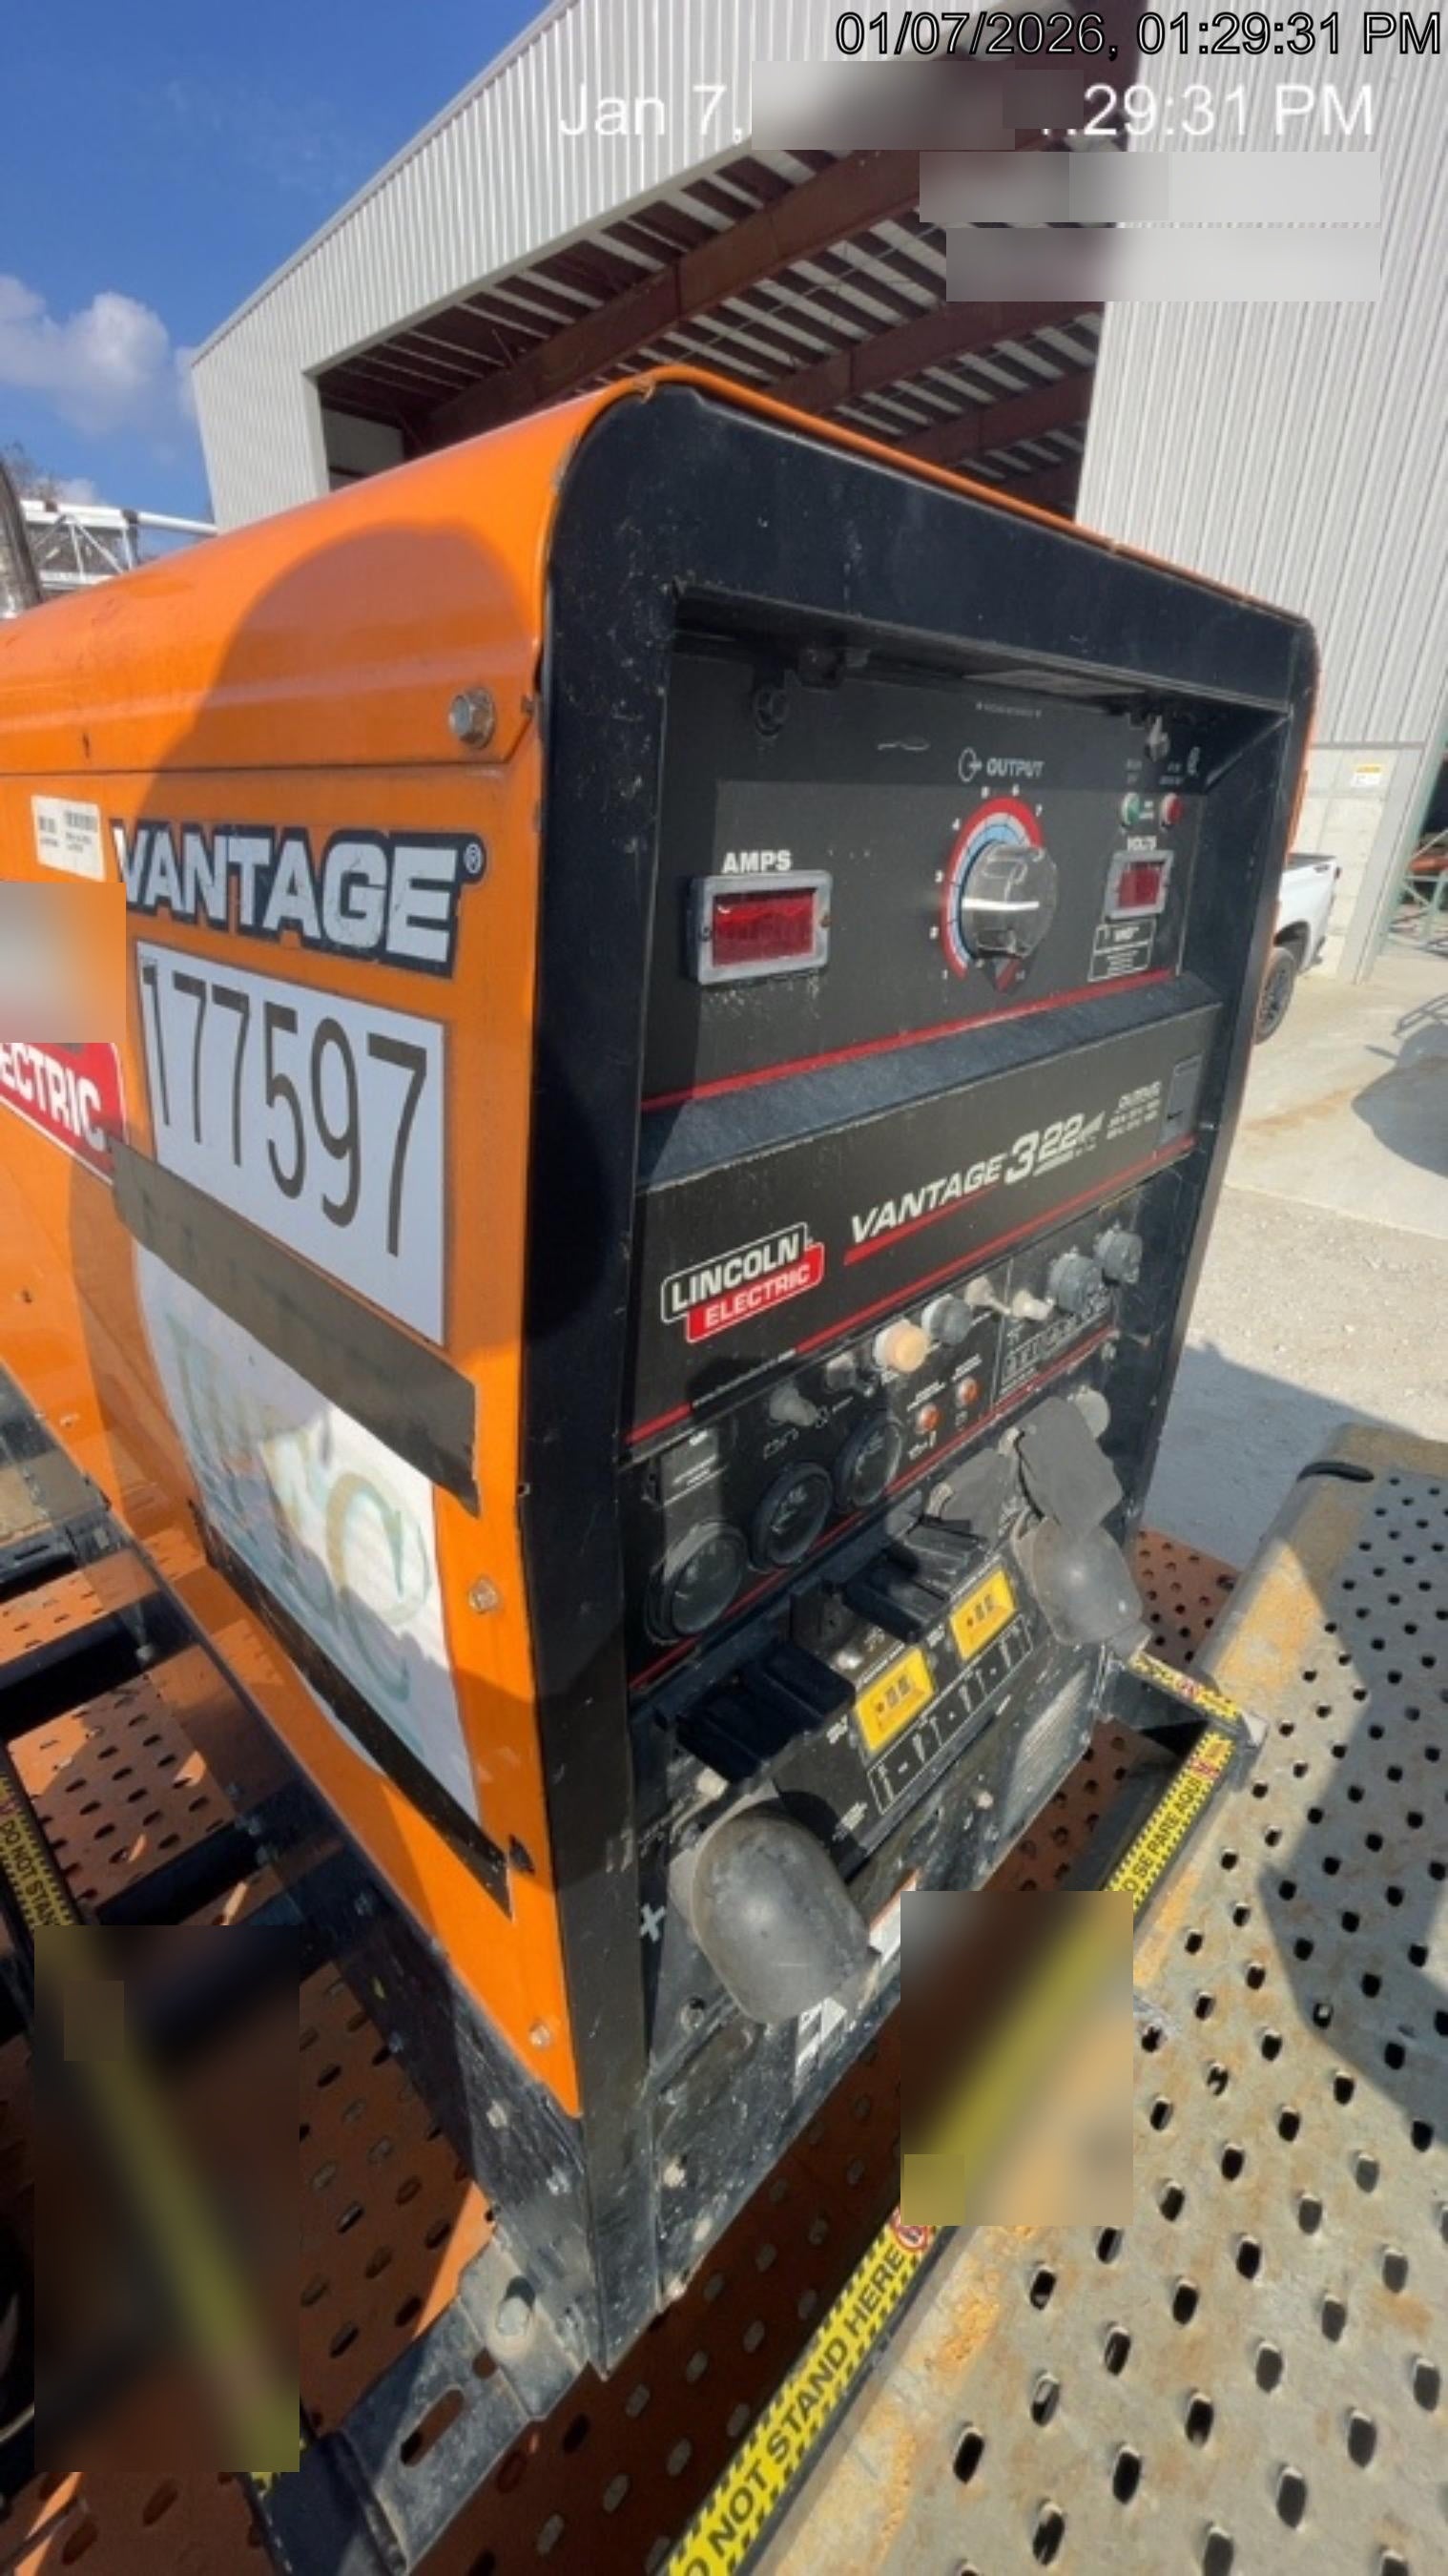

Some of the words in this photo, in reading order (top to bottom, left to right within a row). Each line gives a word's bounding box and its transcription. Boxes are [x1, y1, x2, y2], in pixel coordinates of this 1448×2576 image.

[985, 758, 1045, 778] OUTPUT
[721, 848, 793, 874] AMPS
[141, 964, 428, 1258] 177597
[851, 1153, 1008, 1243] VANTAGE
[671, 1233, 800, 1313] LINCOLN
[704, 1264, 812, 1329] ELECTRIC
[707, 2459, 770, 2558] NOT
[765, 2337, 849, 2467] STAND
[843, 2244, 906, 2337] HERE
